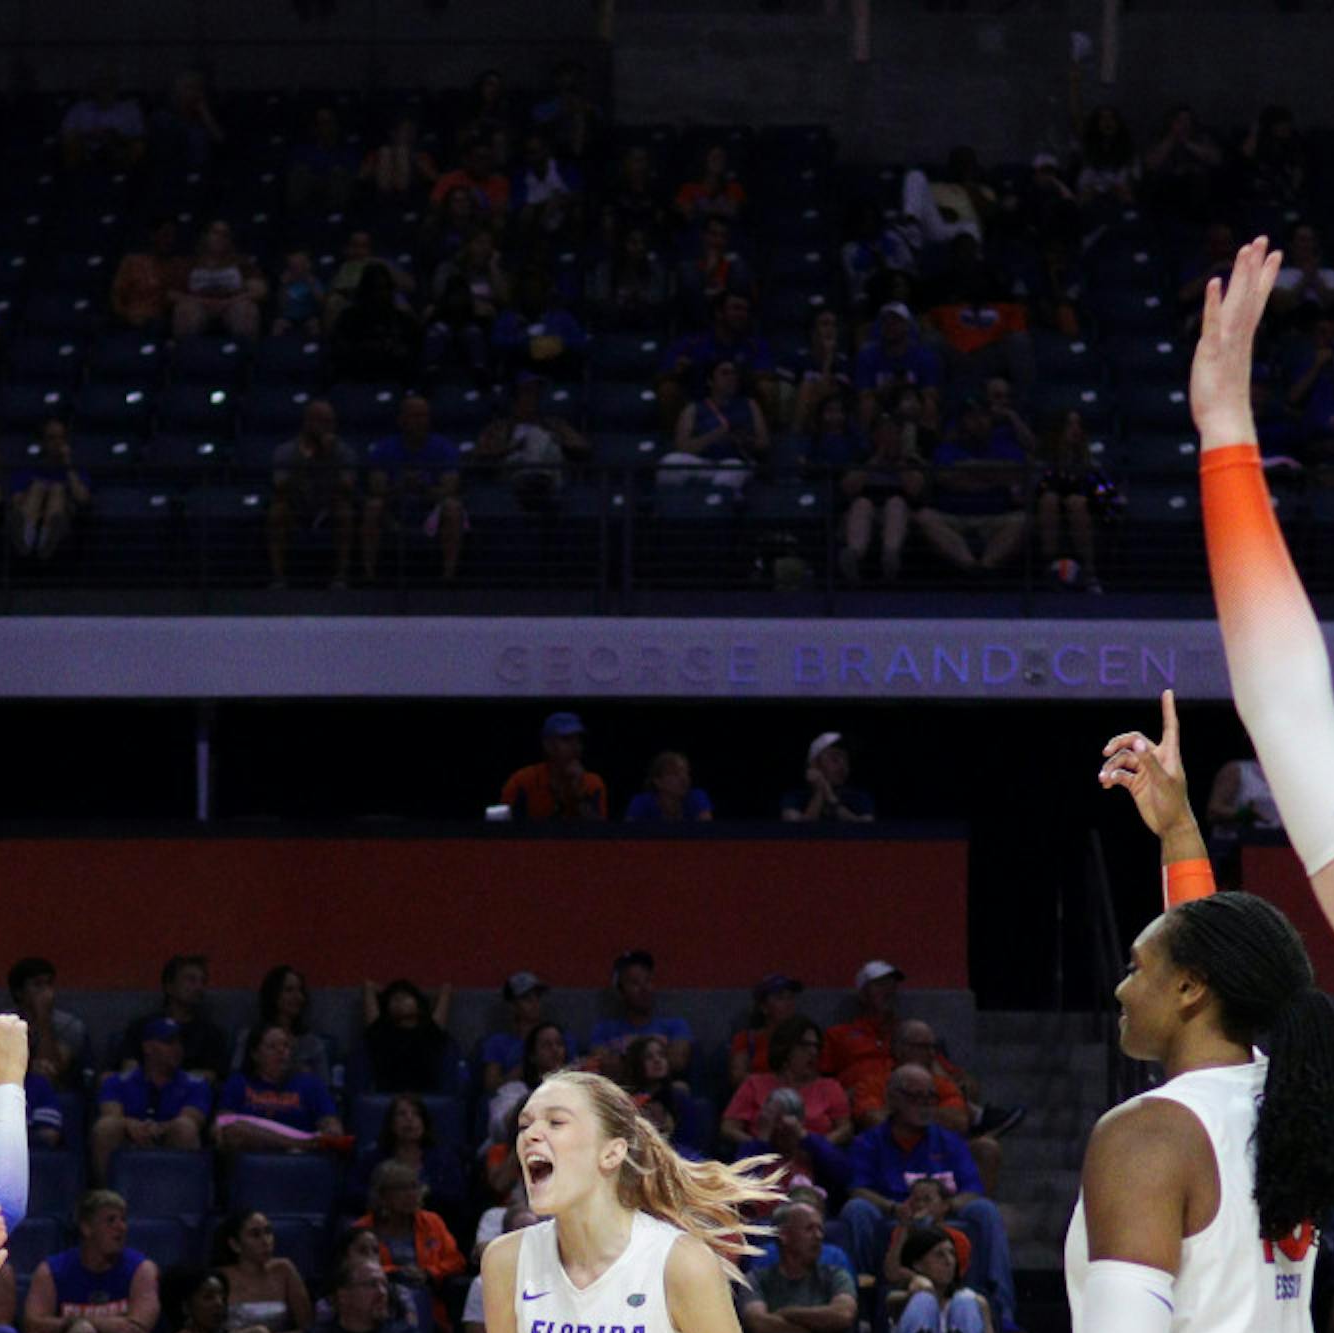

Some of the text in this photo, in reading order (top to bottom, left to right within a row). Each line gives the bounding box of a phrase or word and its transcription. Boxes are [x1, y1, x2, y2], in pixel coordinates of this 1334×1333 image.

[493, 645, 760, 684] GEORGE
[793, 645, 1021, 685] BRAND
[1052, 645, 1218, 687] CENT
